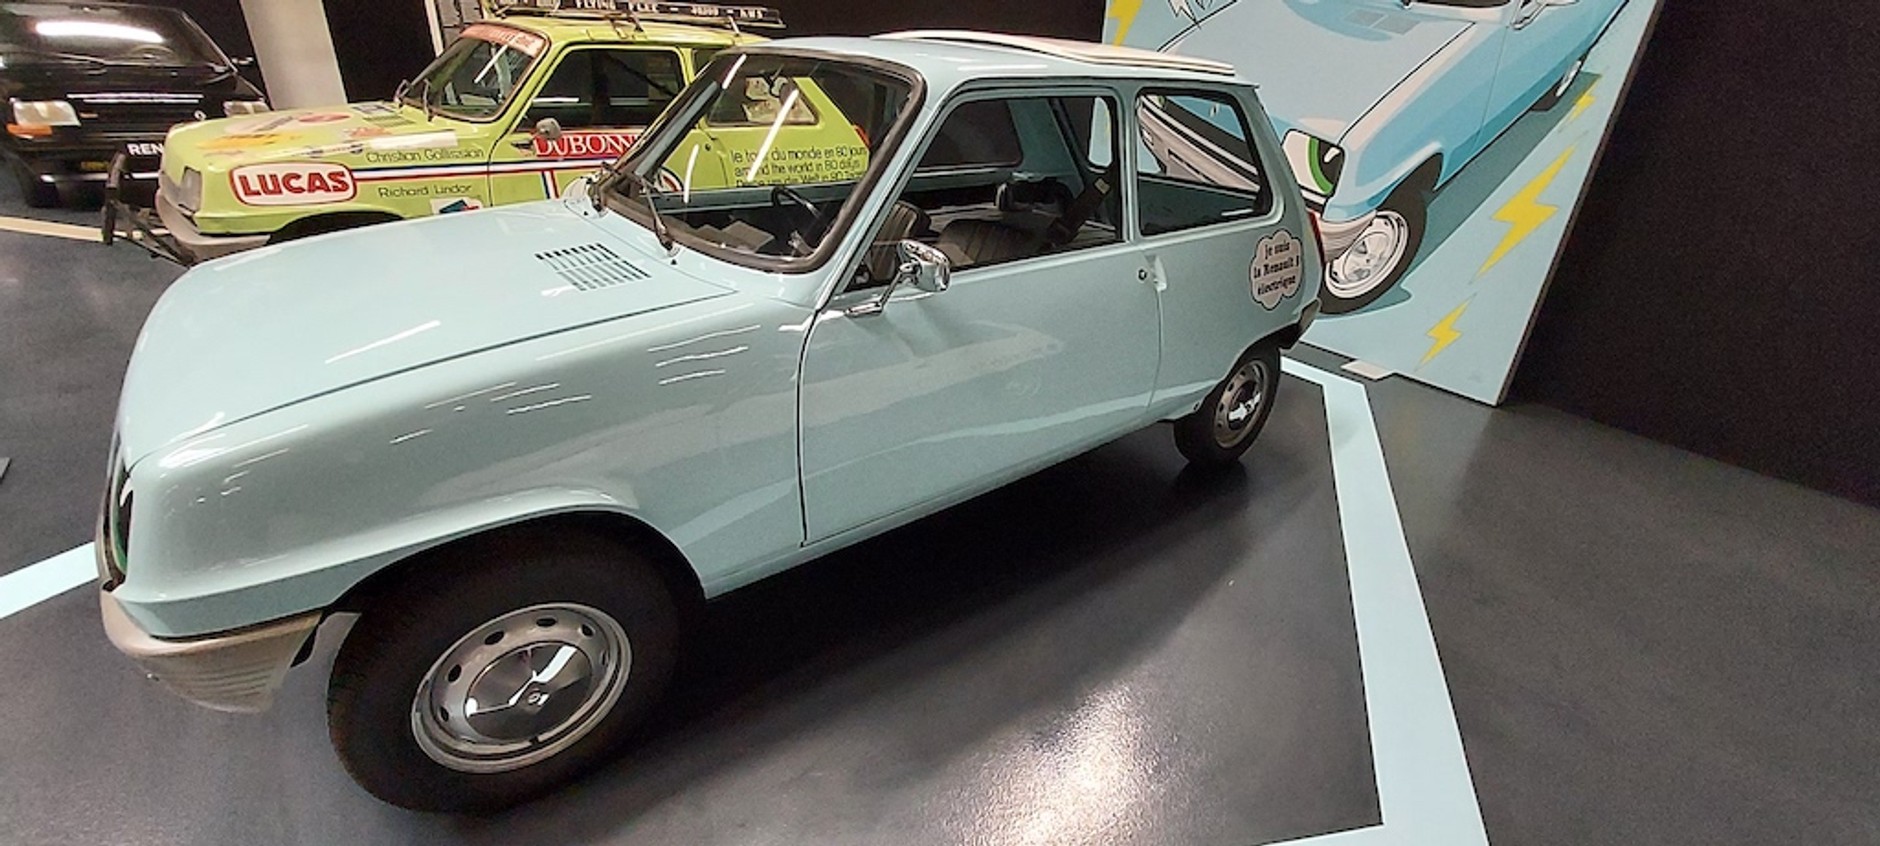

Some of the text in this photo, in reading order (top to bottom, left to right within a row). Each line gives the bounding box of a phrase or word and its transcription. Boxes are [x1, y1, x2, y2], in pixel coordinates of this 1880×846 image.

[366, 149, 421, 163] Christian
[771, 147, 787, 161] du
[788, 146, 822, 160] monde
[836, 145, 848, 157] 80
[824, 159, 838, 172] 80
[237, 170, 350, 197] LUCAS
[378, 186, 429, 198] Richard
[1263, 256, 1294, 276] Renault
